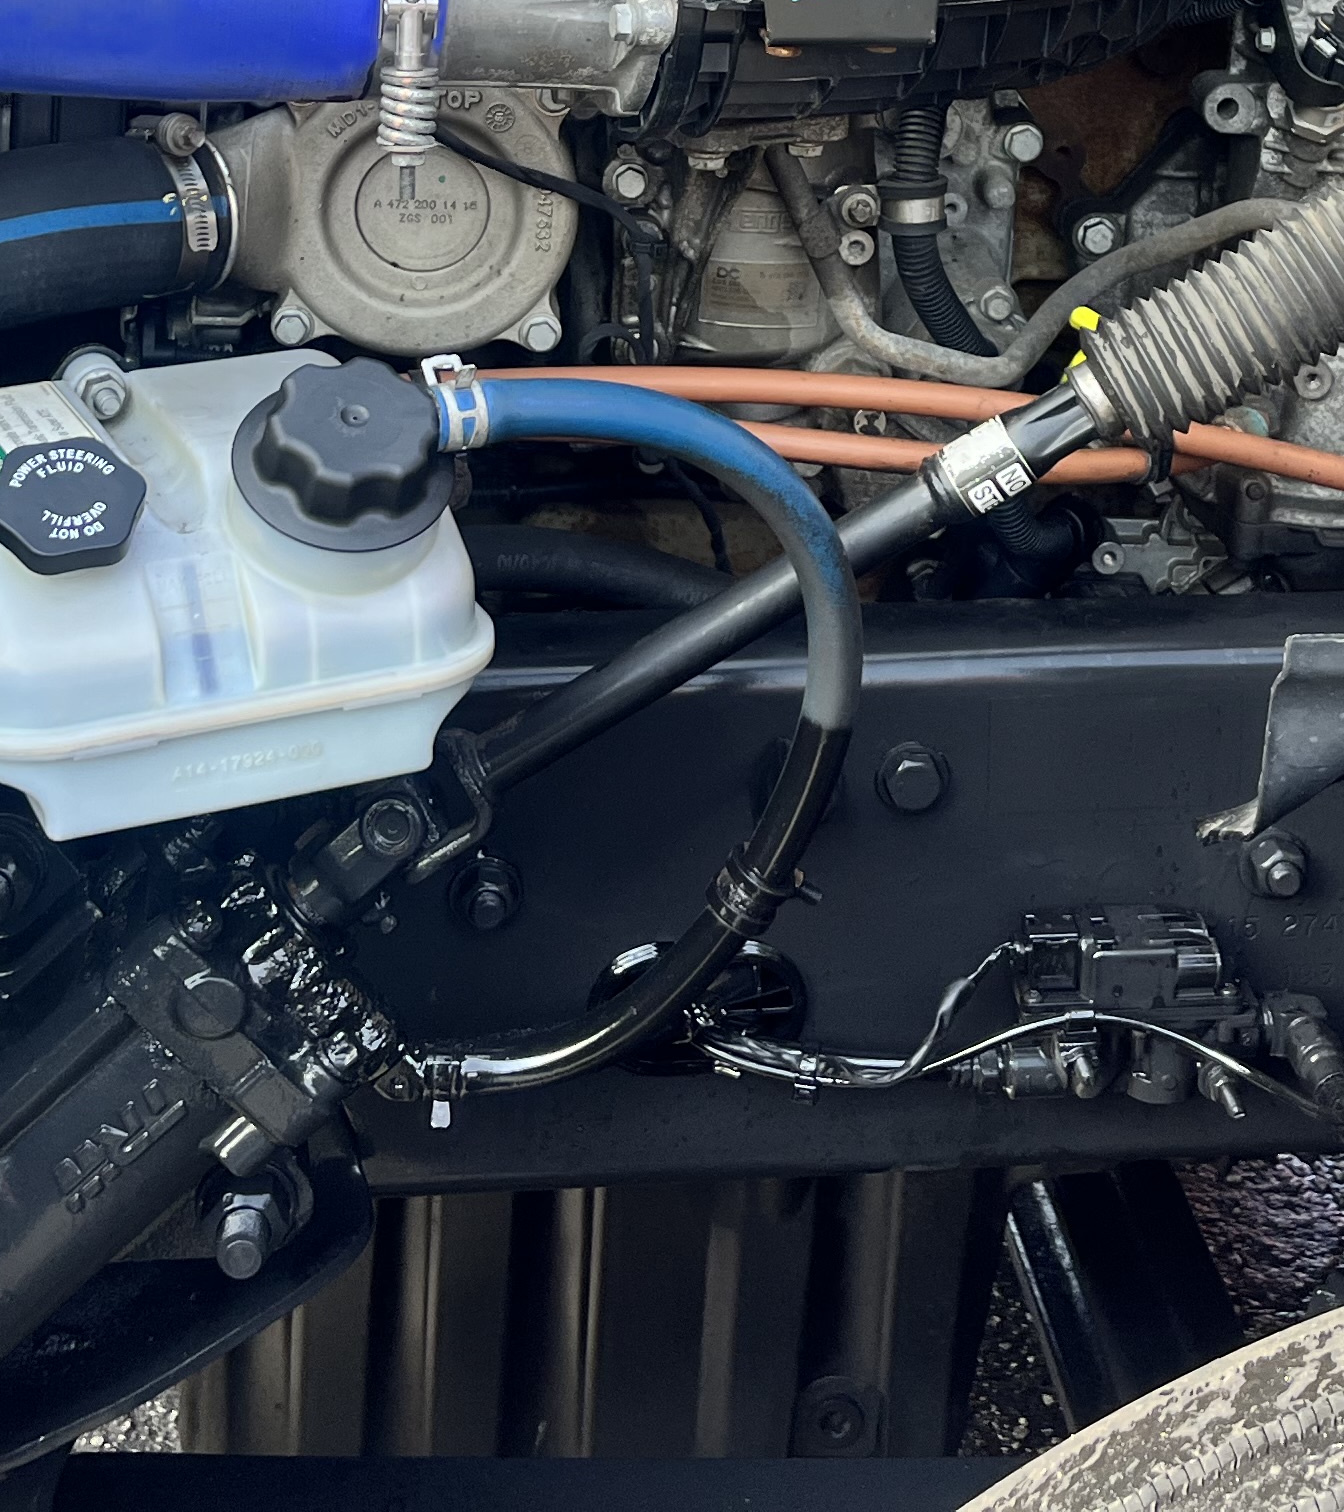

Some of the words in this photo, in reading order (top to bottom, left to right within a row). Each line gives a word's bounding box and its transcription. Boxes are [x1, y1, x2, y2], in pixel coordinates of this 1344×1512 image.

[373, 199, 382, 209] A
[387, 199, 409, 209] 472
[414, 199, 437, 210] 200
[399, 213, 422, 224] ZGS
[9, 452, 48, 489] POWER
[48, 448, 115, 476] STEERING
[36, 460, 84, 479] FLUID
[1002, 468, 1026, 492] NO
[41, 500, 107, 527] OVERFILL
[49, 526, 80, 540] NOT
[83, 520, 105, 537] DO
